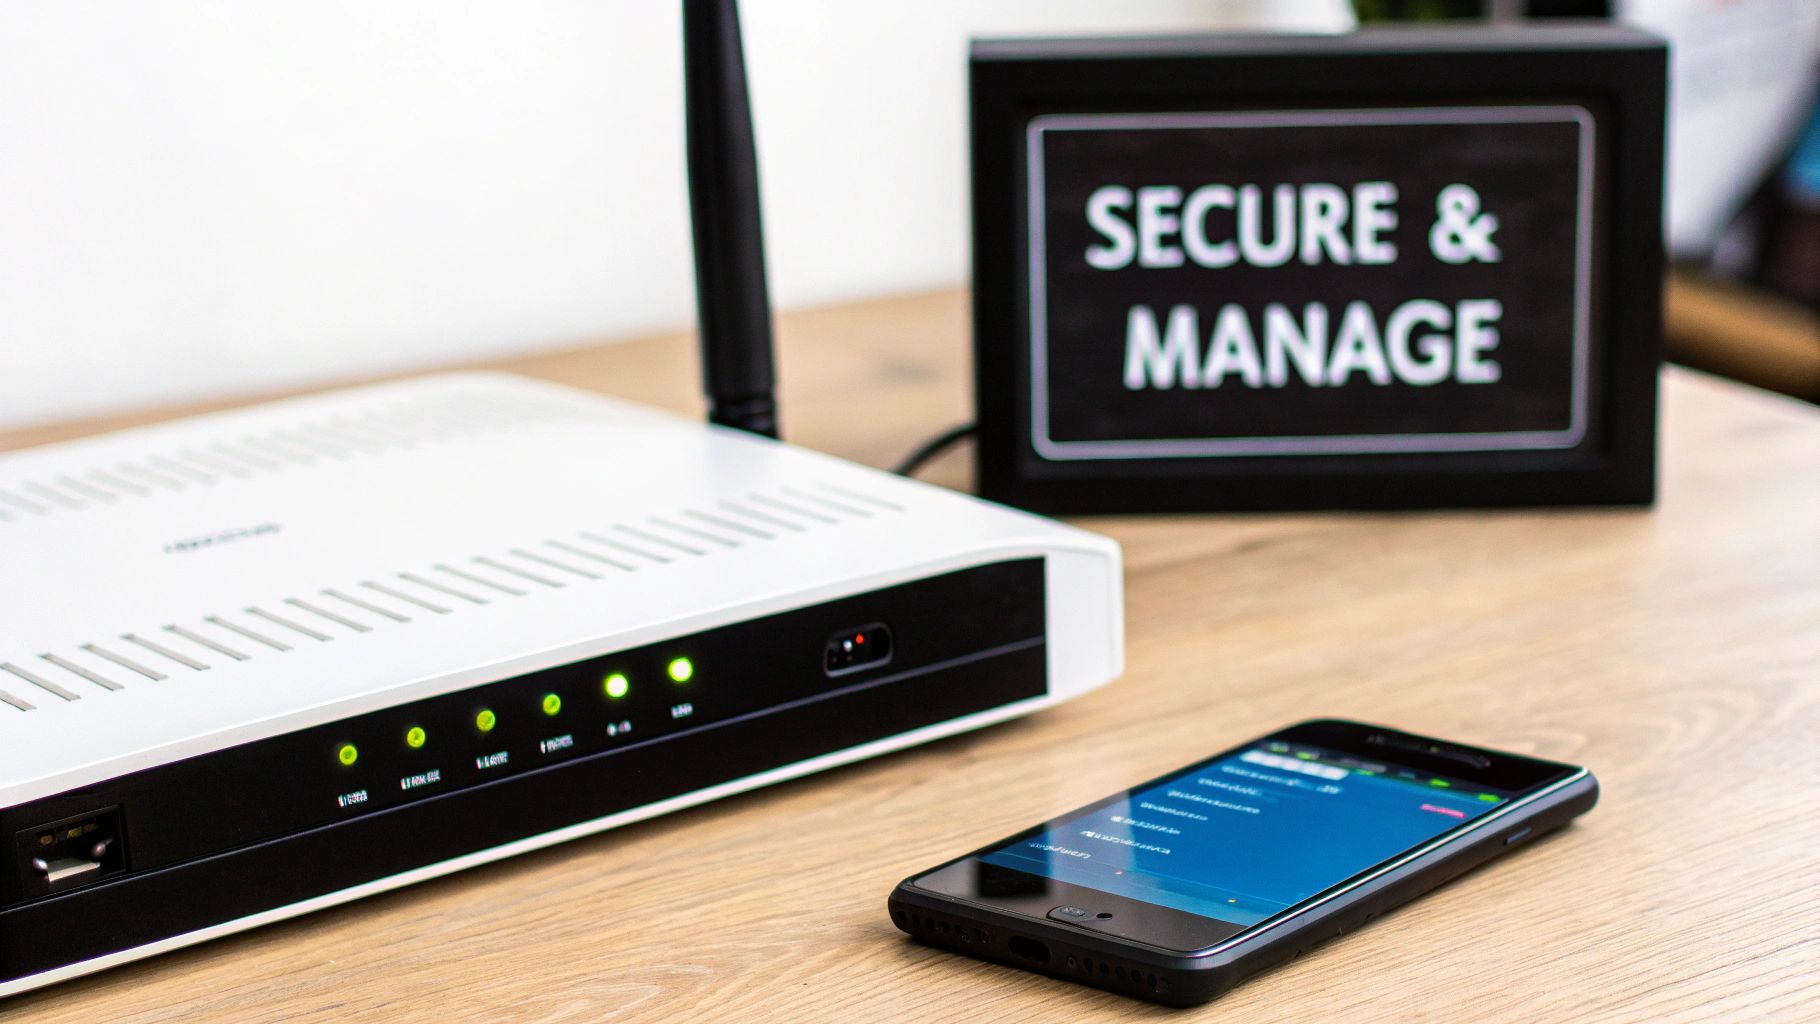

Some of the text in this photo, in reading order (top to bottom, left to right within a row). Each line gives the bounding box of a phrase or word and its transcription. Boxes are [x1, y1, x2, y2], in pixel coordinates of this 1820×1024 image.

[1085, 182, 1499, 269] SECURE &
[1123, 299, 1503, 389] MANAGE
